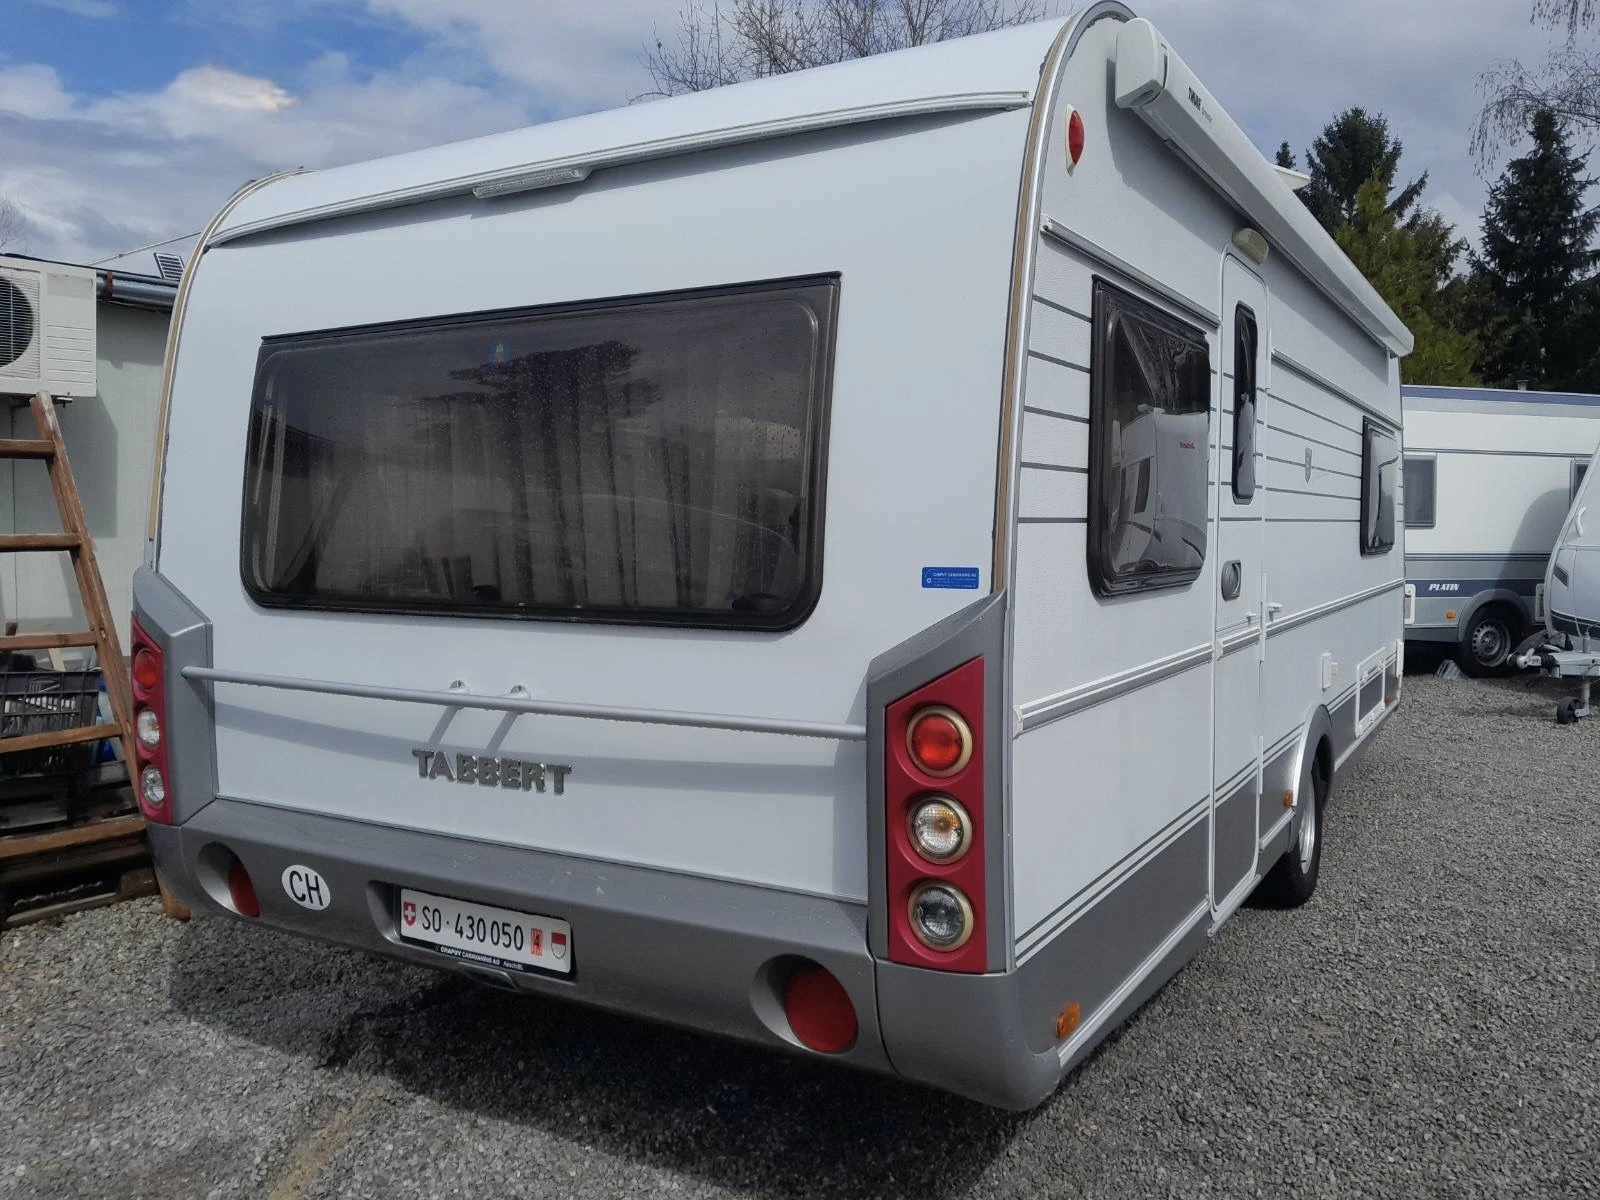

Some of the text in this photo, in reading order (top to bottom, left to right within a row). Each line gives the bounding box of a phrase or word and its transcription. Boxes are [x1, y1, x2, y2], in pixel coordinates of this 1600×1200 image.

[1428, 583, 1460, 591] PLATIN
[412, 749, 572, 795] TABBERT
[289, 870, 324, 906] CH
